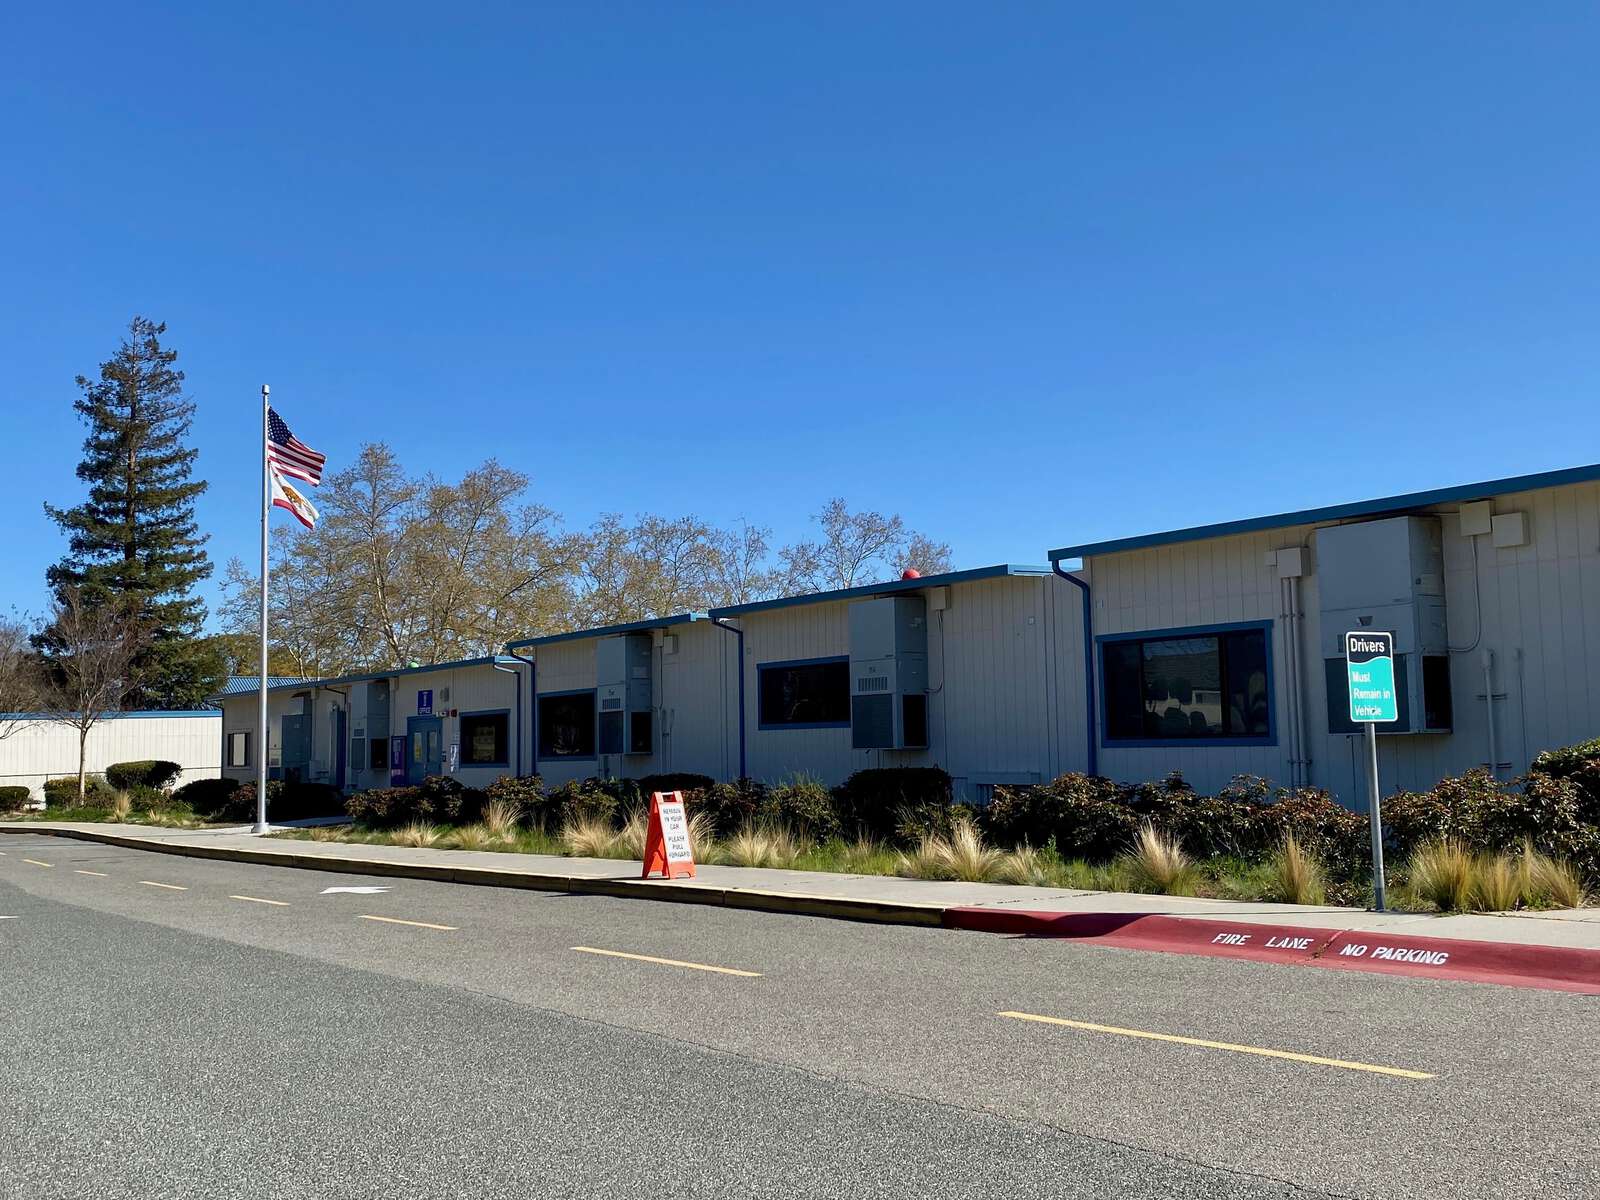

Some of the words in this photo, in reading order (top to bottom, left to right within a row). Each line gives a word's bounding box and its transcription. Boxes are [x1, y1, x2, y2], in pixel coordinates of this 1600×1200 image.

[1350, 638, 1385, 652] Drivers
[1352, 671, 1371, 682] Must
[1353, 688, 1381, 699] Remain
[1383, 689, 1390, 699] in
[1355, 704, 1382, 717] Vehicle
[1211, 933, 1251, 945] FIRE
[1265, 936, 1314, 950] LANE
[1340, 943, 1367, 957] NO
[1370, 946, 1449, 965] PARKING
